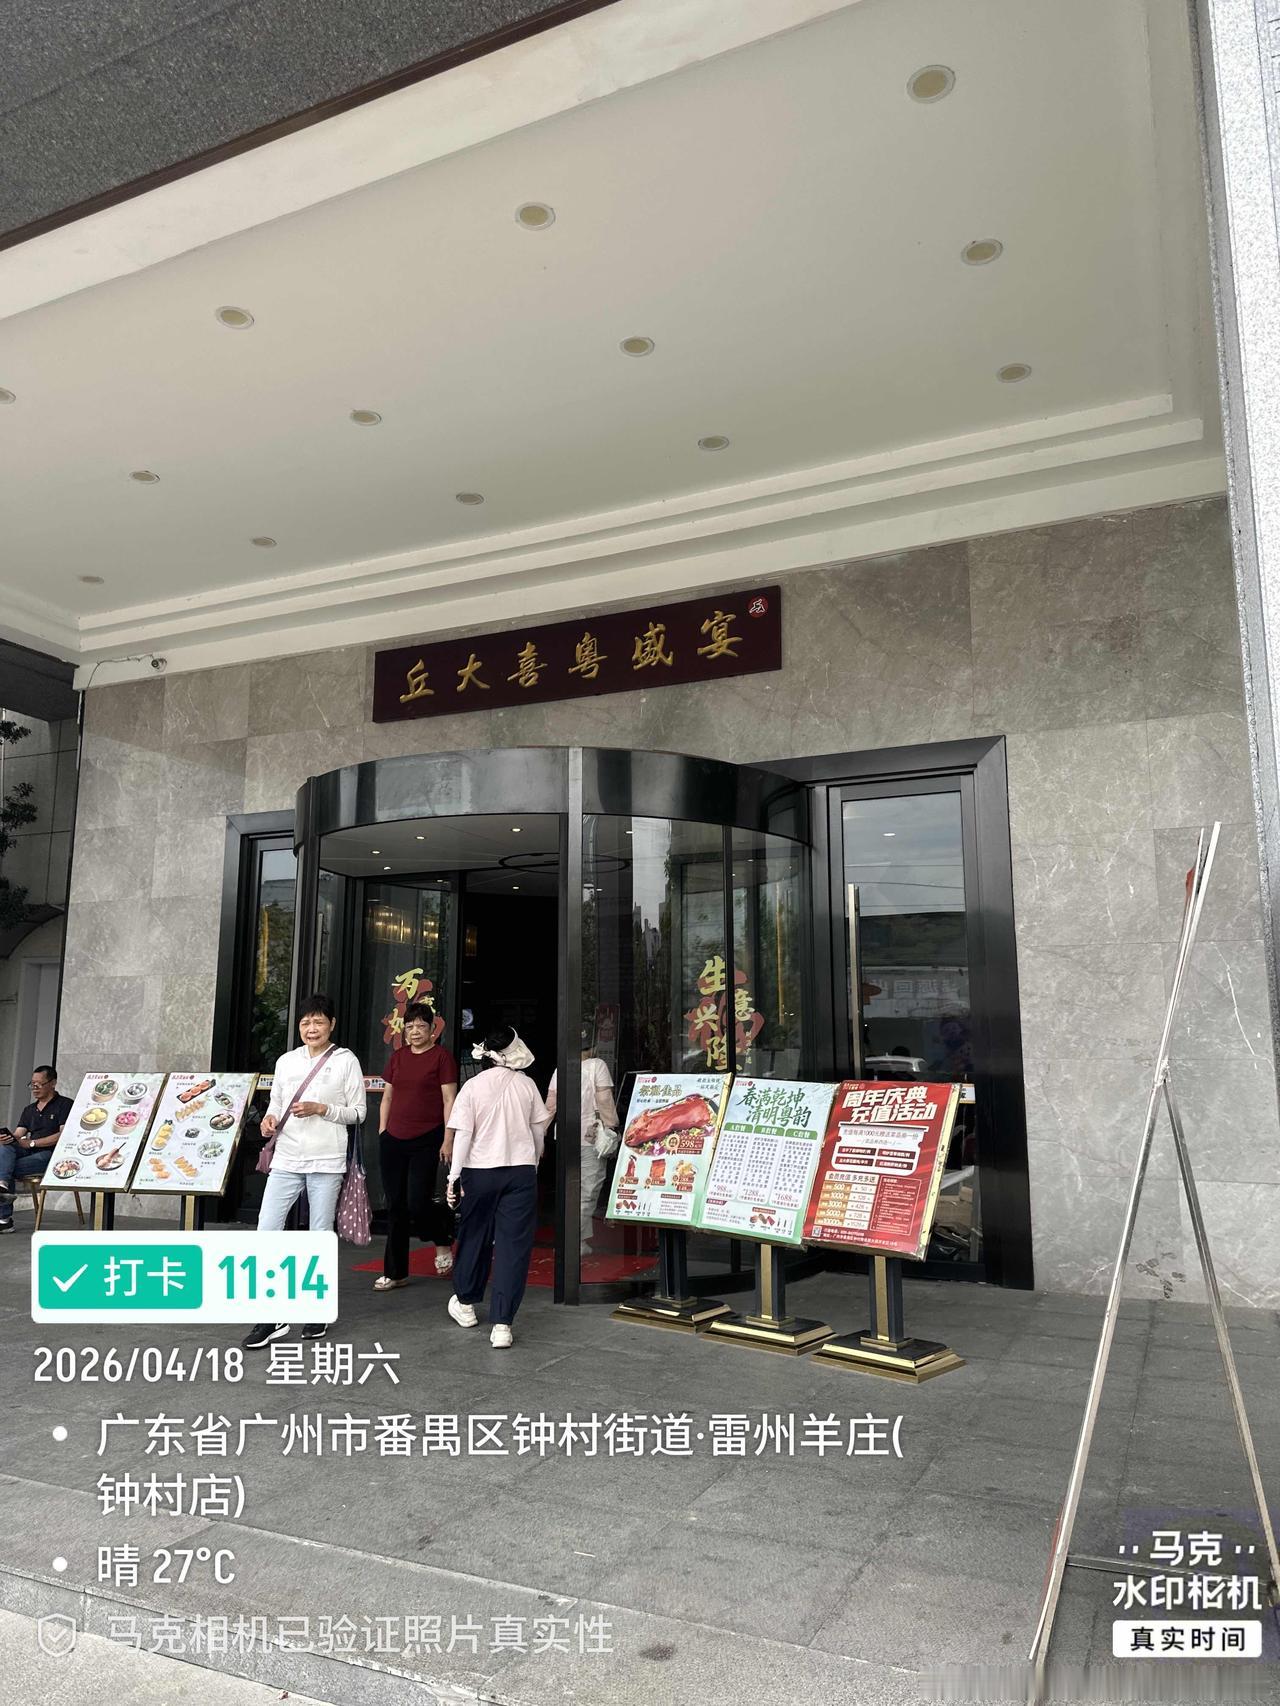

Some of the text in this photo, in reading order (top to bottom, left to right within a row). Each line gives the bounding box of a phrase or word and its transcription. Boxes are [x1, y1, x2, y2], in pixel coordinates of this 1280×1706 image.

[736, 1083, 805, 1111] 春满乾坤
[842, 1086, 928, 1109] 周年庆典
[746, 1105, 812, 1128] 清明粤韵
[850, 1102, 938, 1124] 充值活动
